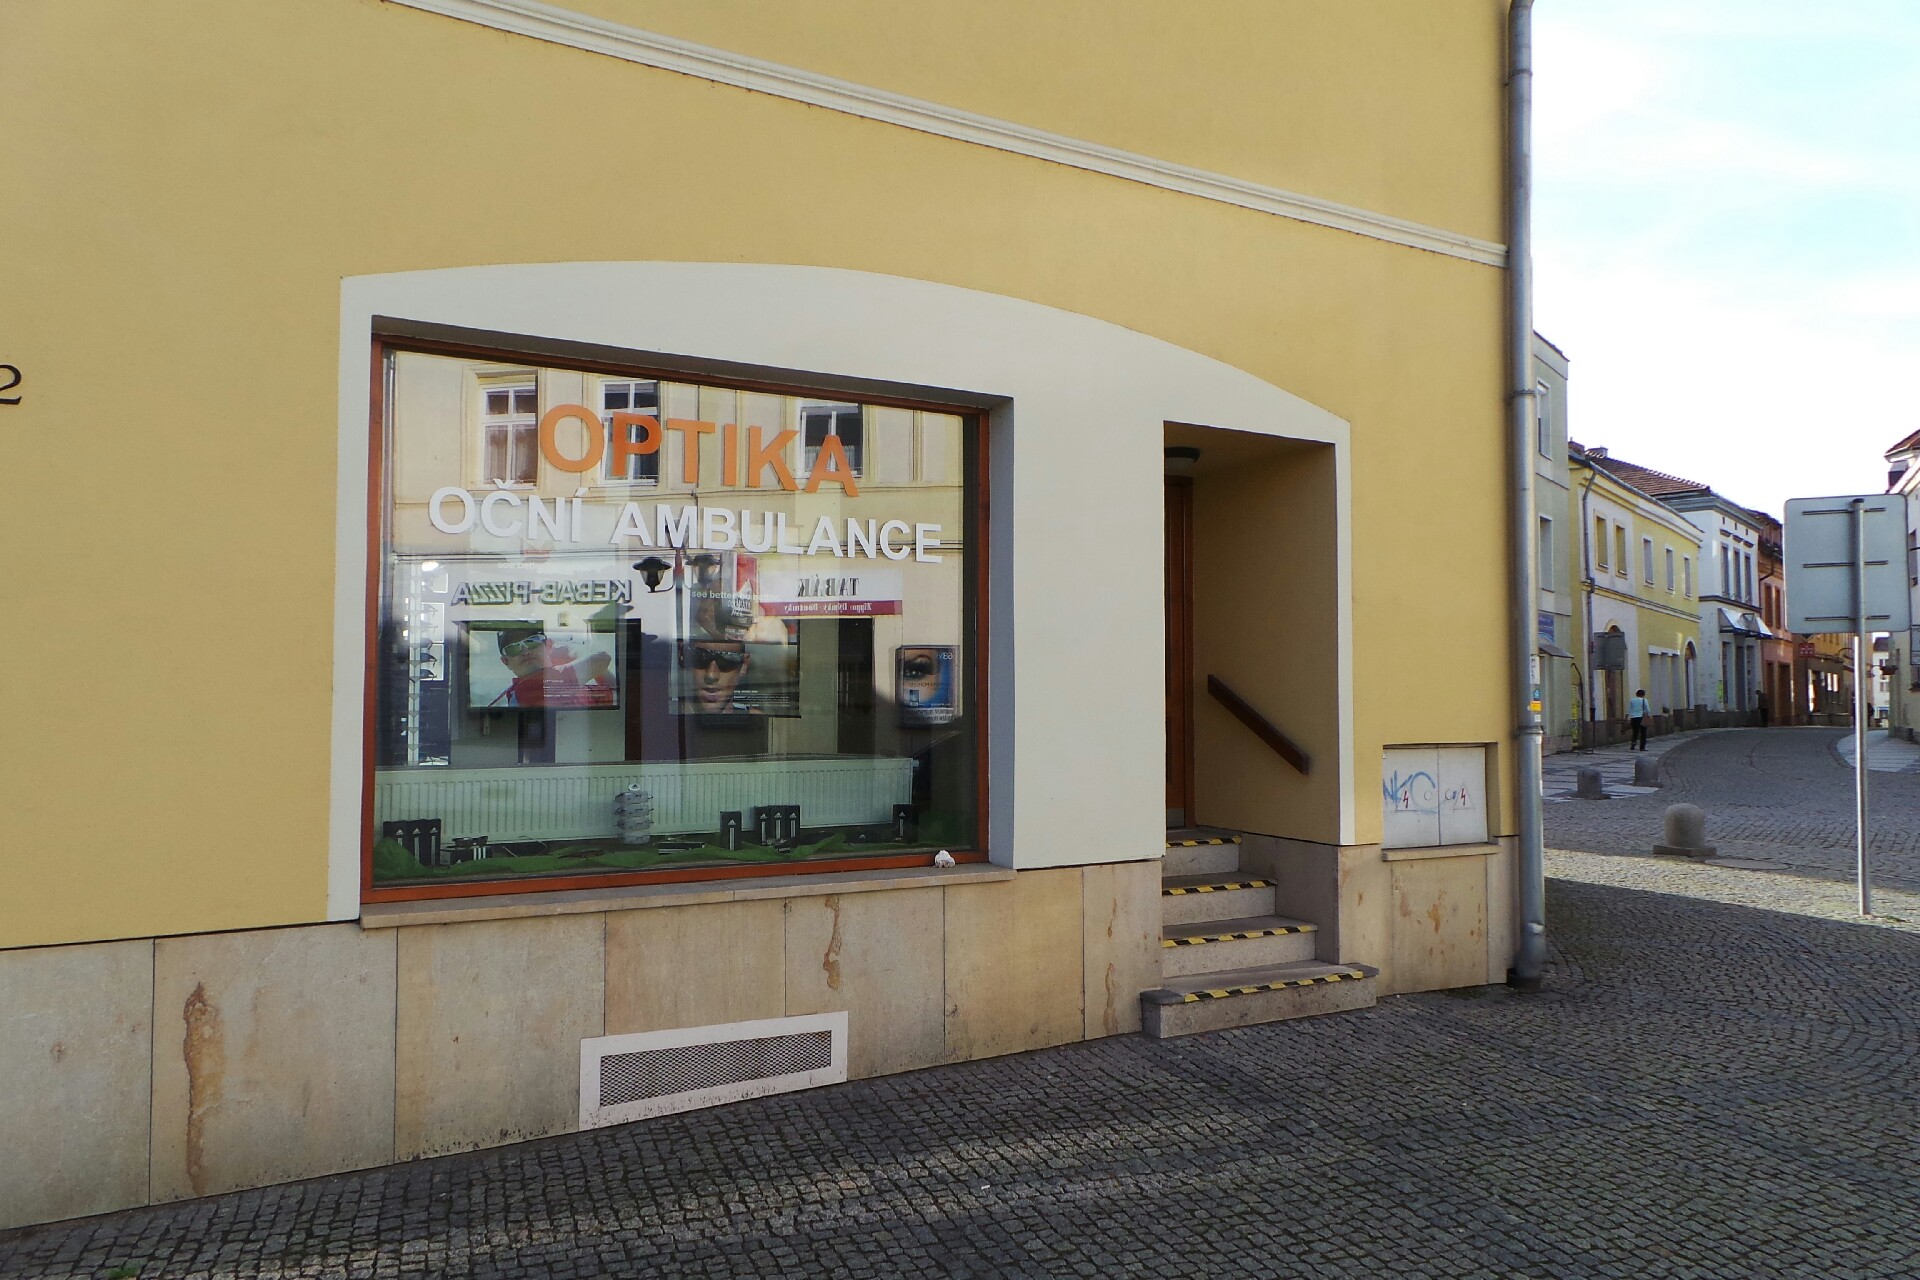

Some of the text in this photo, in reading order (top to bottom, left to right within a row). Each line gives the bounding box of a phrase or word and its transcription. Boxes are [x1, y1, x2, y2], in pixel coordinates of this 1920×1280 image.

[539, 404, 859, 497] OPTIKA
[428, 479, 943, 564] OČNÍ AMBULANCE
[691, 590, 708, 599] see
